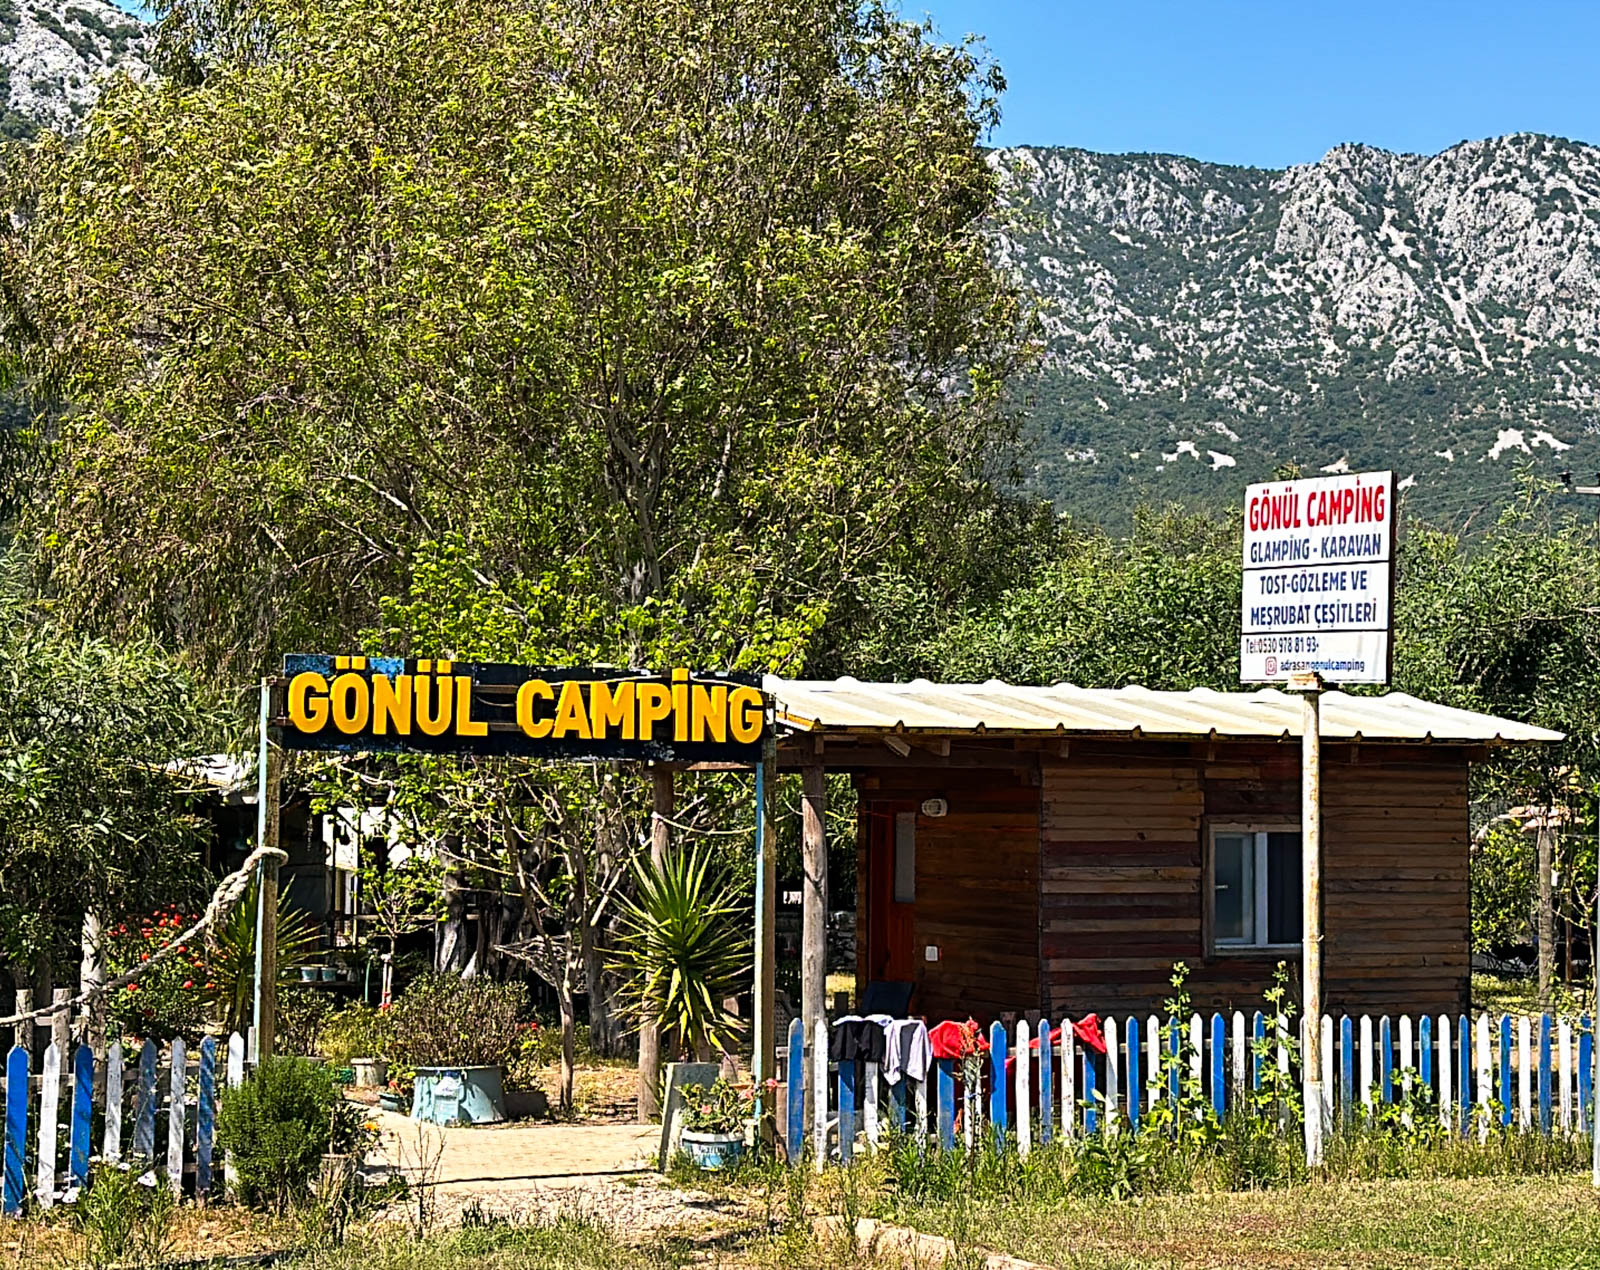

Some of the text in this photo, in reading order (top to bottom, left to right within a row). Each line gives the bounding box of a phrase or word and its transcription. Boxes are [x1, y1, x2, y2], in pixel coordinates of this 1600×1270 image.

[1249, 476, 1385, 532] GÖNÜL CAMPİNG
[1250, 534, 1310, 563] GLAMPİNG
[1321, 533, 1381, 559] KARAVAN
[1260, 569, 1367, 595] TOST-GÖZLEME VE
[1250, 598, 1377, 630] MEŞRUBAT ÇEŞİTLERİ
[1278, 637, 1292, 653] 978
[1294, 637, 1304, 653] 81
[288, 656, 764, 744] GÖNÜL CAMPİNG
